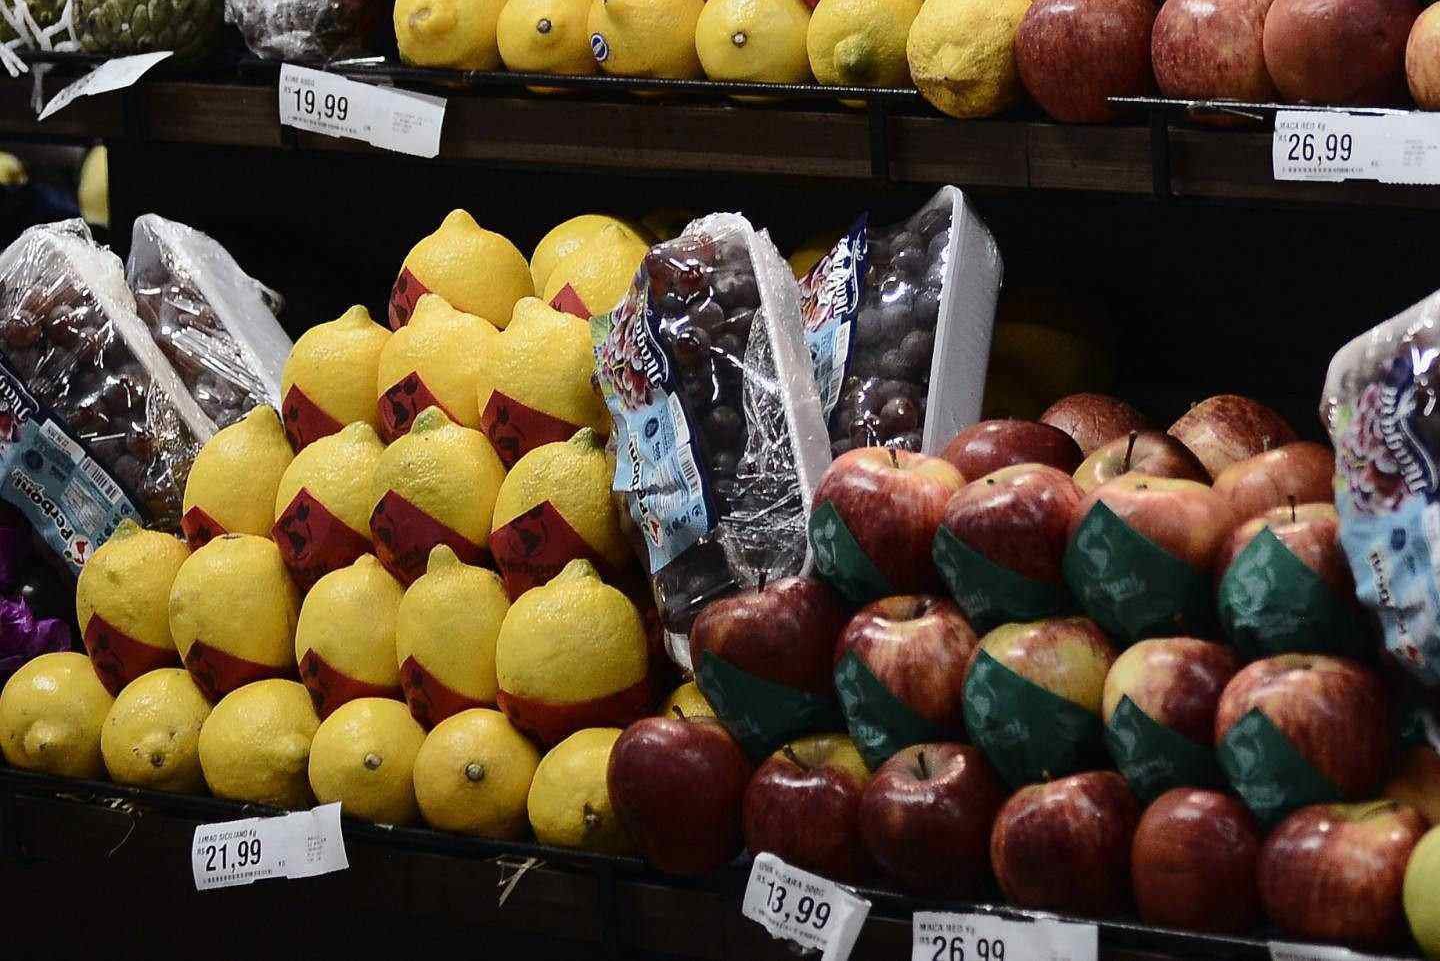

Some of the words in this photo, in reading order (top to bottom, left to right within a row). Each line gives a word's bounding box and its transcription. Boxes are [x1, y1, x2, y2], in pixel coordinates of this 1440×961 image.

[293, 88, 348, 120] 19,99
[1288, 134, 1352, 166] 26,99
[206, 839, 261, 873] 21,99
[767, 881, 831, 929] 13,99
[932, 936, 1005, 960] 2699
